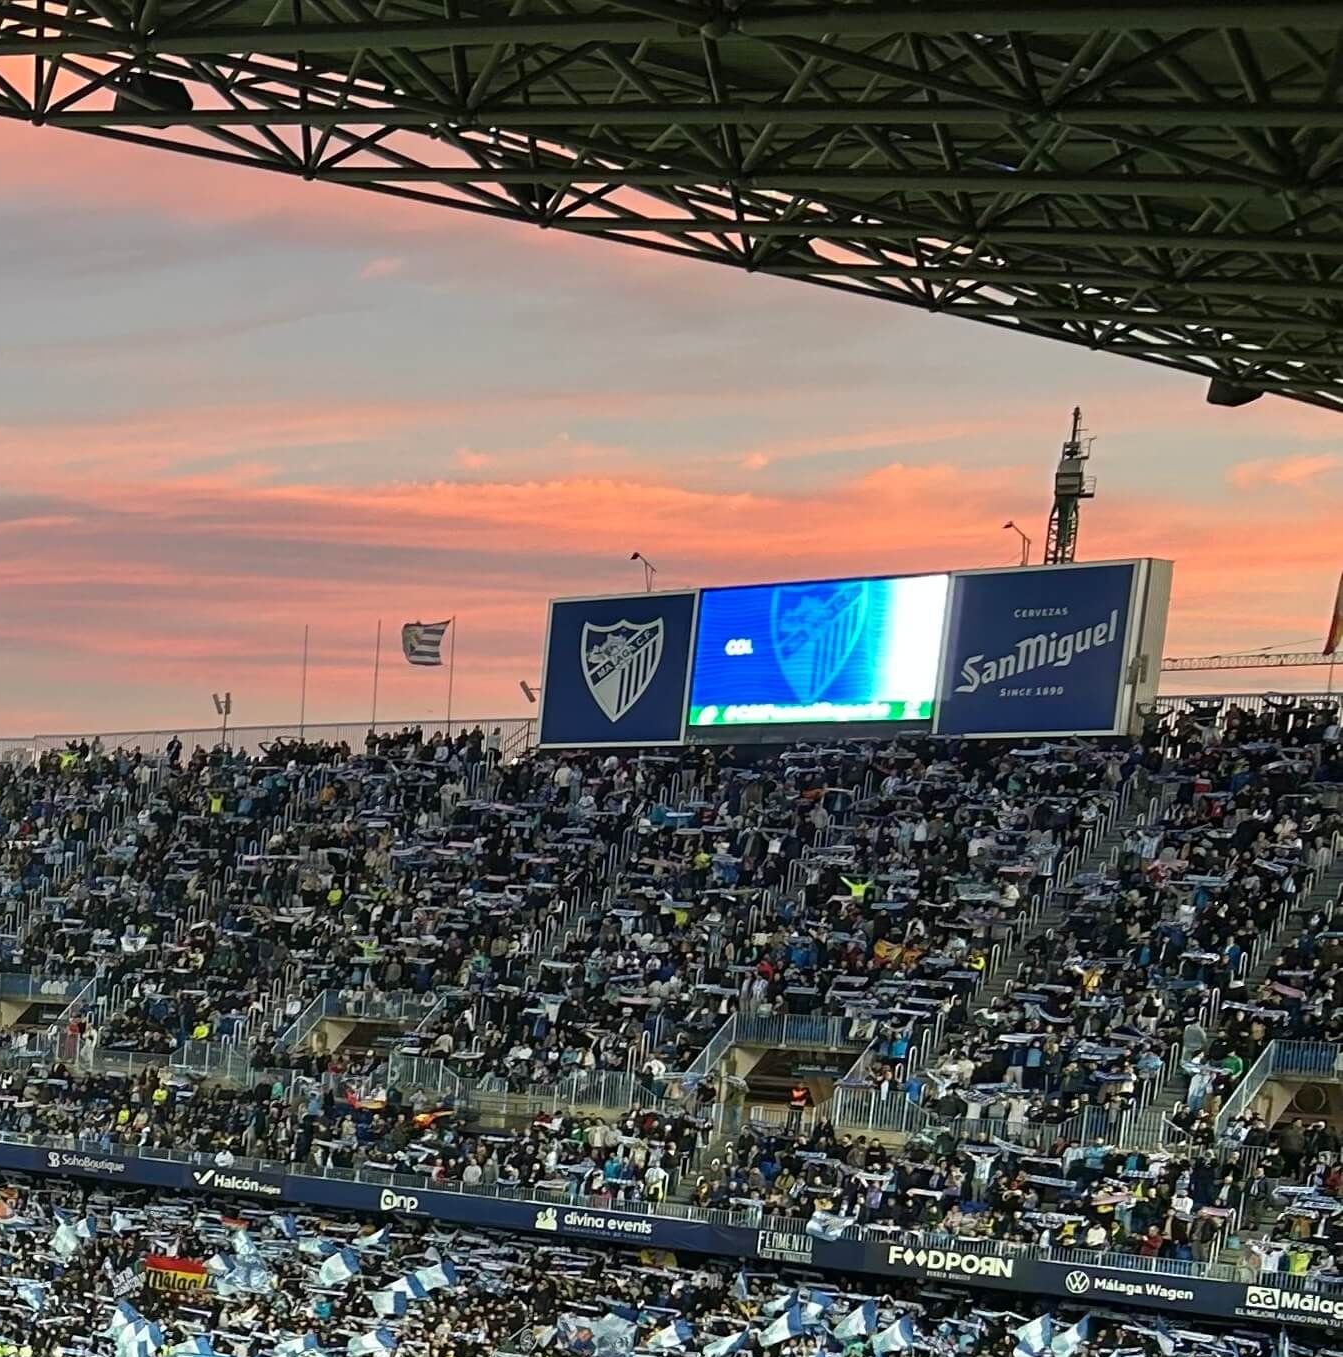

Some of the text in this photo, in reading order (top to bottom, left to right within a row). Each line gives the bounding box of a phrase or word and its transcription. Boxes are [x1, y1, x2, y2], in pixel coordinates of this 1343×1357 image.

[1014, 607, 1068, 618] CERVEZAS
[1000, 686, 1064, 697] SINCE 1890
[214, 1174, 259, 1192] Halcón
[1094, 1276, 1143, 1296] Málaga
[1145, 1284, 1194, 1300] Wagen
[1280, 1291, 1343, 1319] Málag
